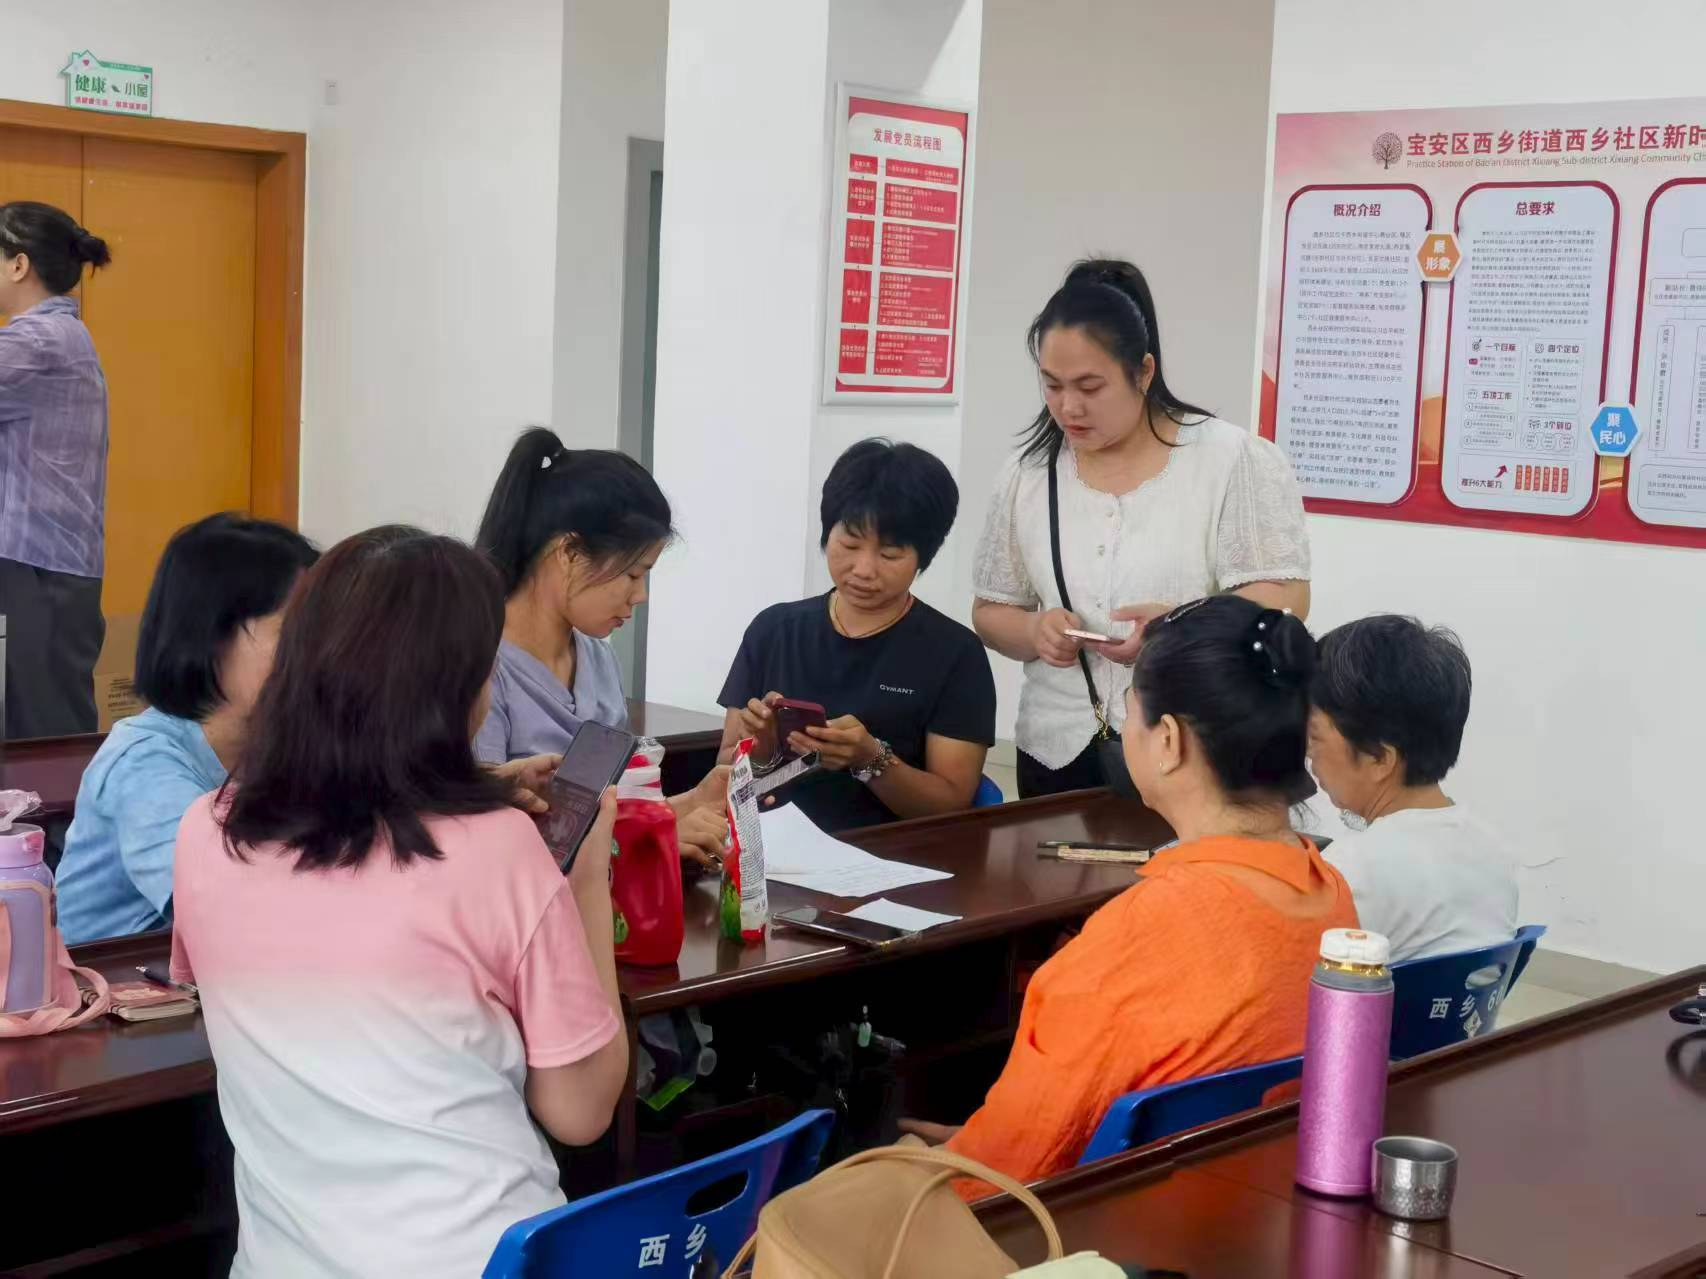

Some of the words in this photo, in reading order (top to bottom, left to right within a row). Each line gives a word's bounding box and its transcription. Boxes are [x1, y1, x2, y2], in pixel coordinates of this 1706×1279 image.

[75, 74, 106, 94] 健康
[125, 82, 148, 98] 小屋
[873, 128, 942, 151] 发展党员流程图
[1407, 124, 1706, 156] 宝安区西乡街道西乡社区新时
[1407, 160, 1436, 169] Practice
[1437, 160, 1464, 168] Station
[1465, 159, 1474, 167] of
[1503, 158, 1530, 167] District
[1640, 153, 1692, 164] Community
[1333, 203, 1381, 217] 概况介绍
[1516, 201, 1556, 216] 总要求
[1425, 256, 1451, 271] 形象
[1599, 429, 1627, 446] 民心
[1428, 994, 1476, 1019] 西乡
[638, 1223, 707, 1269] 西乡
